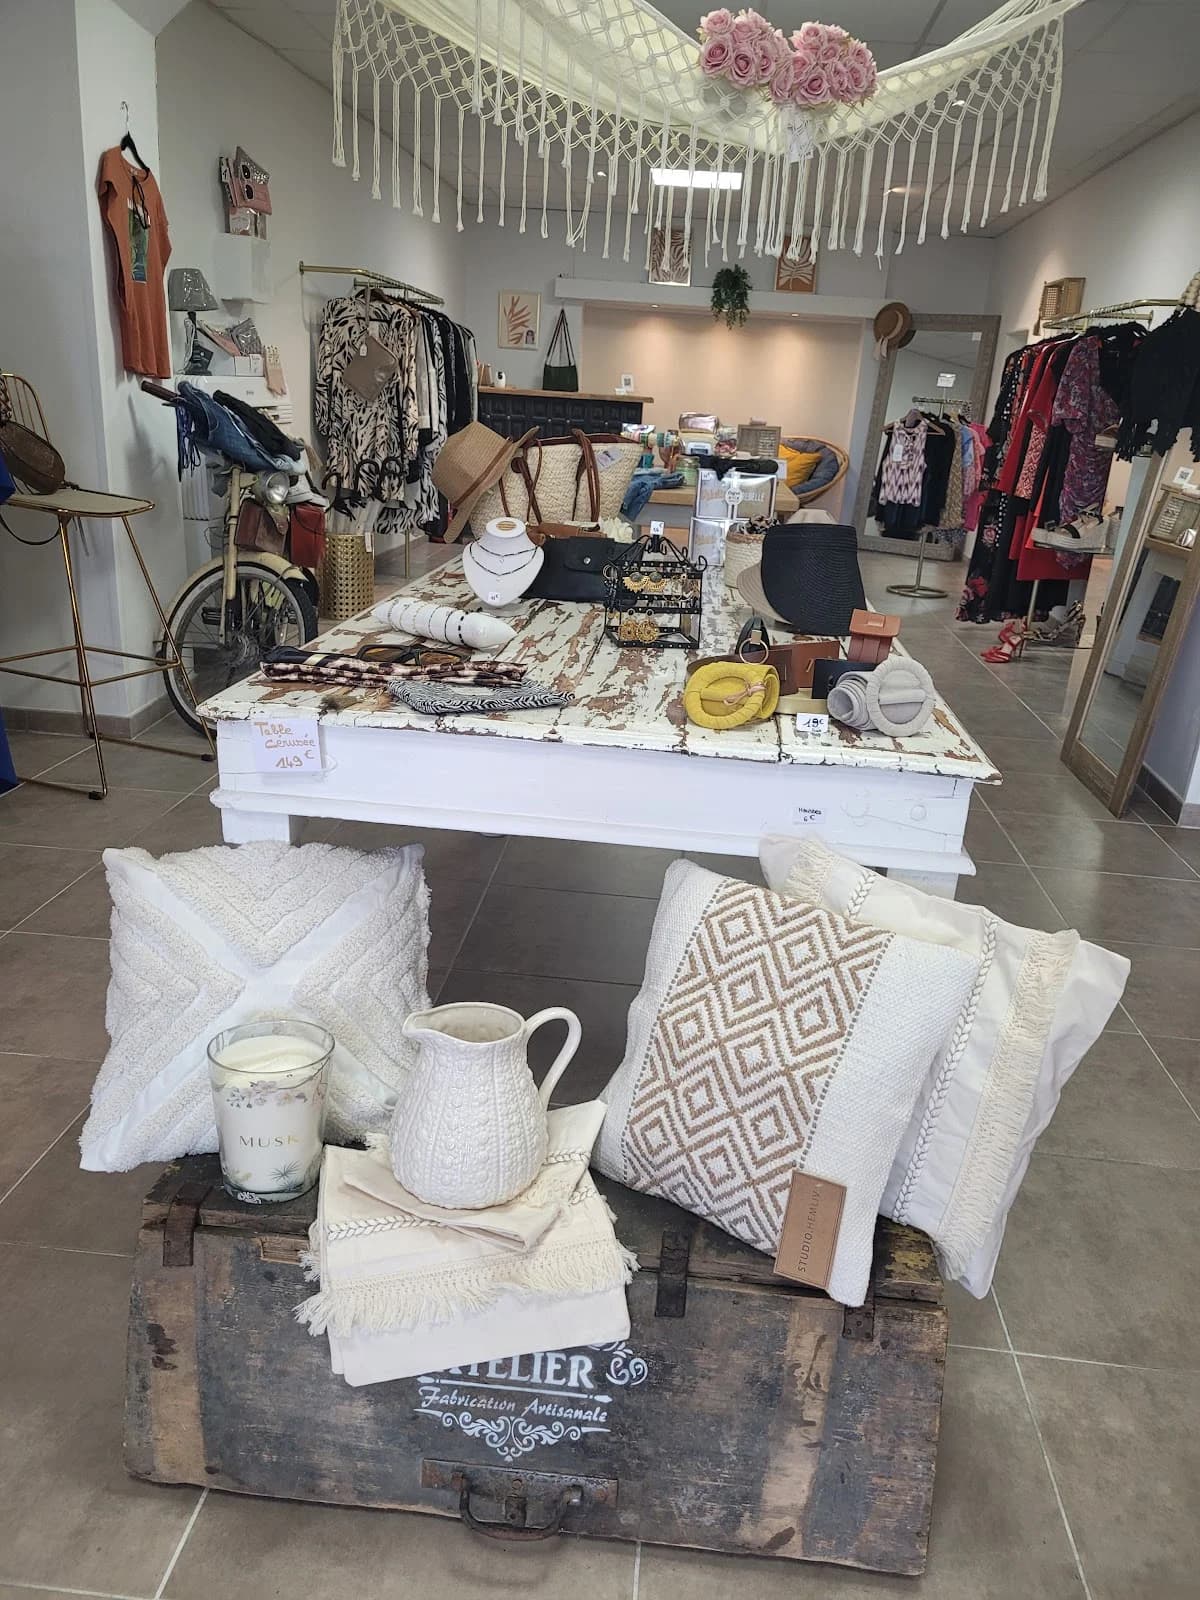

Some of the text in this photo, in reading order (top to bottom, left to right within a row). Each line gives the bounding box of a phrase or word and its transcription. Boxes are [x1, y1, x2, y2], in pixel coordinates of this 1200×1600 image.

[254, 721, 294, 737] Table
[275, 755, 303, 769] 149
[418, 1385, 608, 1423] Fabrication Artisanale
